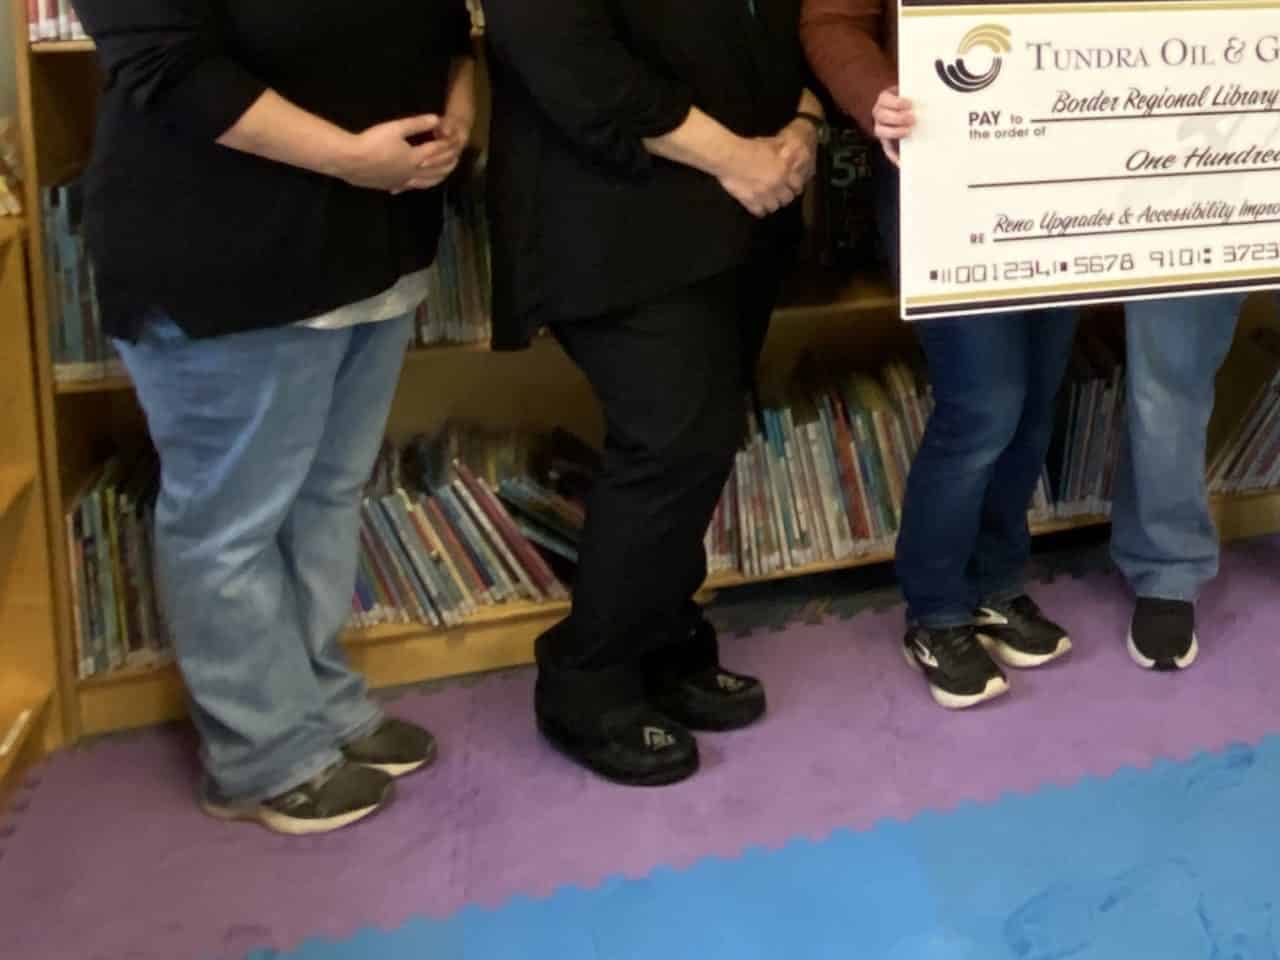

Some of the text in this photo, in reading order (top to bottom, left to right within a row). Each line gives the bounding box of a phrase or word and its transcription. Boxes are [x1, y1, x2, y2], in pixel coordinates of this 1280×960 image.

[1026, 41, 1151, 71] TUNDRA
[1160, 37, 1216, 66] OIL
[1223, 35, 1247, 65] &
[1051, 89, 1120, 114] Border
[1123, 85, 1211, 117] Regional
[1212, 83, 1280, 113] Library
[968, 111, 1023, 127] PAY to
[968, 125, 1047, 140] the order of
[1125, 149, 1177, 172] One
[992, 212, 1035, 234] Reno
[1039, 208, 1116, 237] Upgrades
[1118, 207, 1135, 226] &
[1136, 199, 1235, 225] Accessibility
